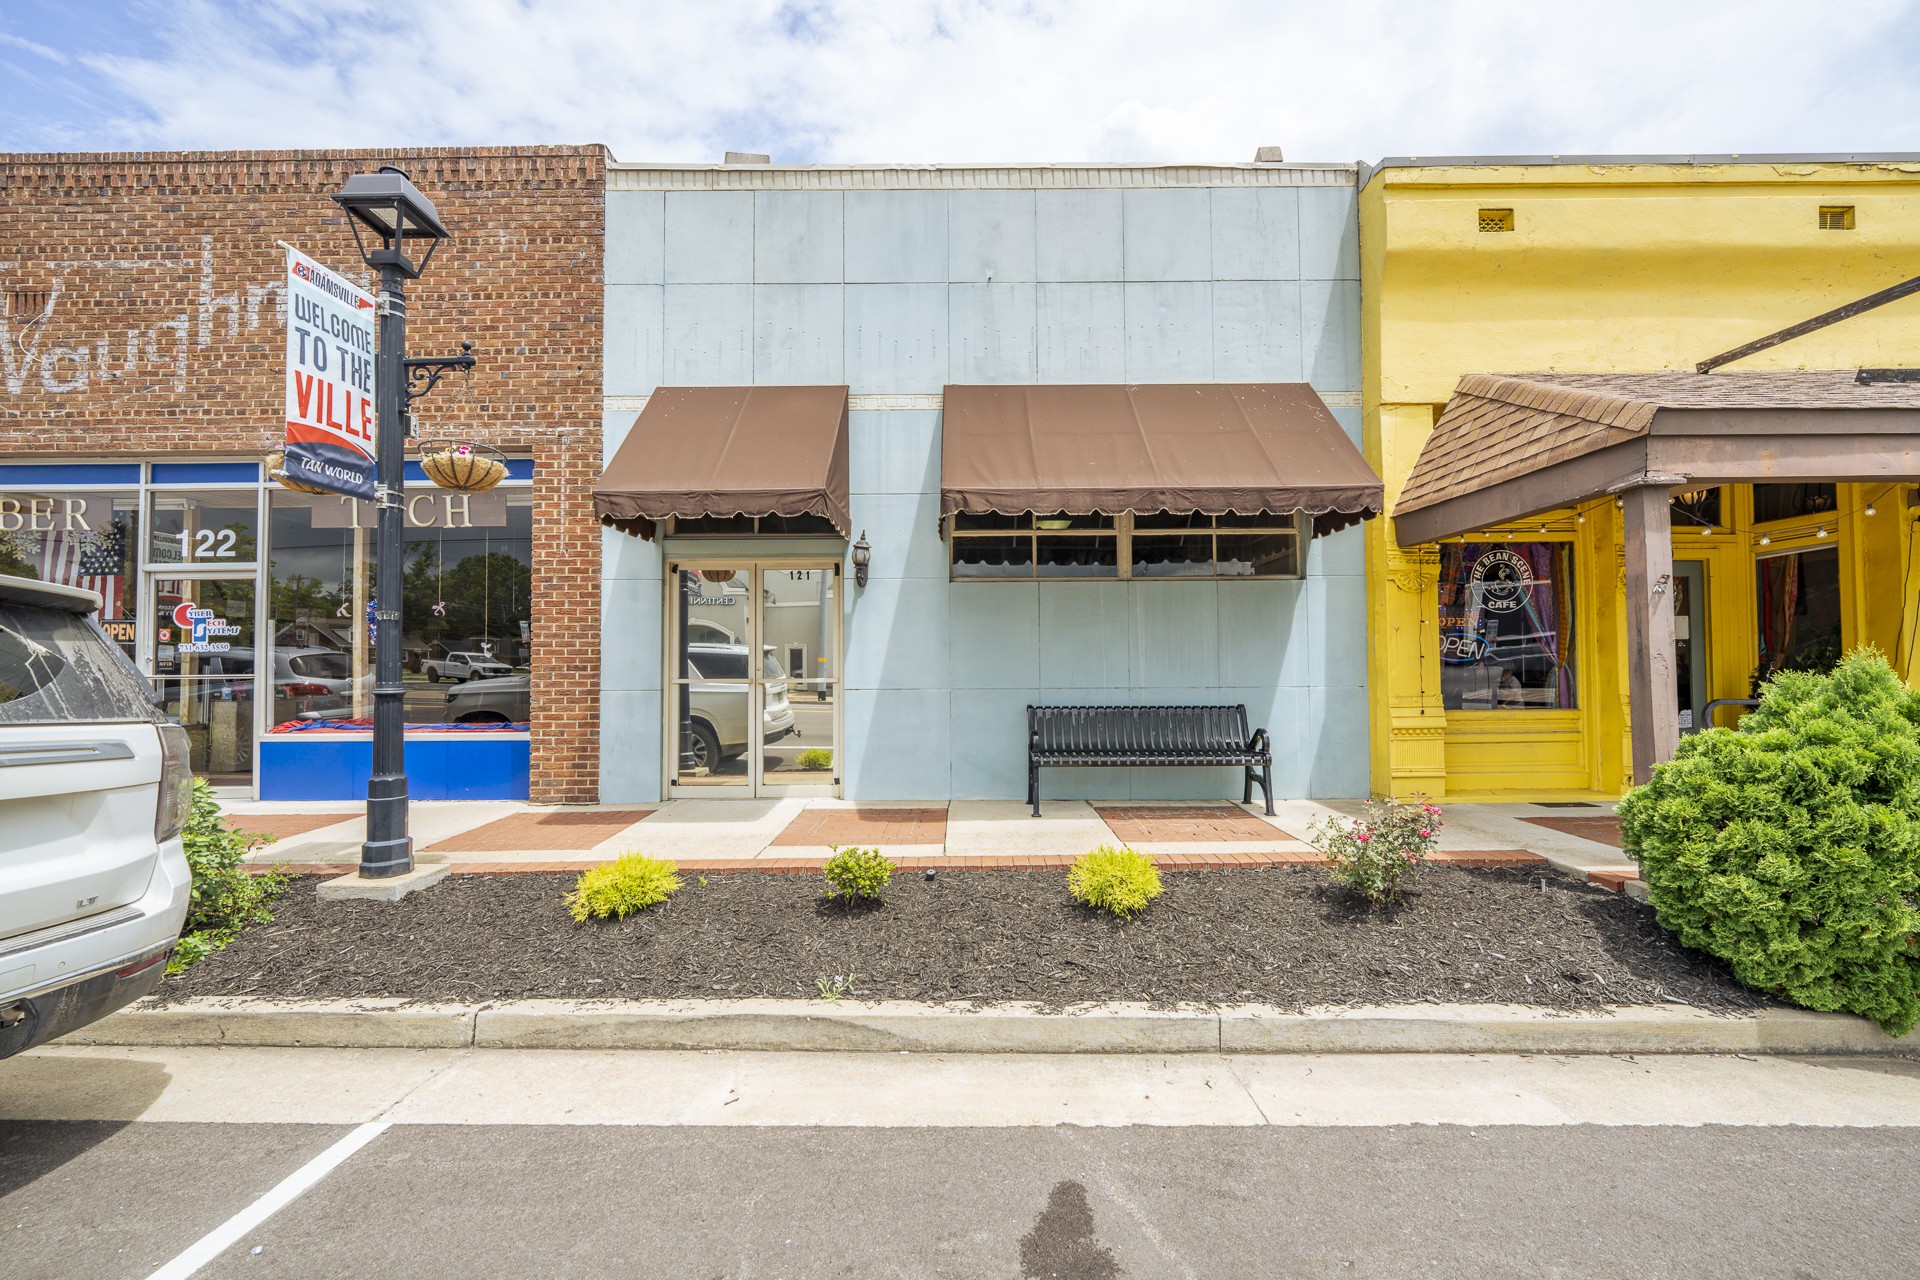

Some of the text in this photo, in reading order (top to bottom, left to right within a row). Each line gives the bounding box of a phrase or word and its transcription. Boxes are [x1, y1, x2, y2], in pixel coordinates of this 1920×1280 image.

[310, 269, 359, 309] ADAMSVILLE
[295, 293, 371, 355] WELCOME
[295, 326, 371, 394] TO THE
[294, 369, 372, 442] VILLE
[301, 456, 363, 485] TAN WORLD
[0, 498, 91, 531] BER
[340, 493, 473, 529] TCH
[176, 529, 237, 557] 122
[789, 570, 811, 581] 121
[1473, 552, 1531, 585] THE BEAN SCENE
[1487, 601, 1517, 609] CAFE
[103, 623, 135, 641] OPEN
[1438, 617, 1478, 627] OPEN
[179, 644, 230, 652] 731-632-3550
[76, 895, 99, 909] LT
